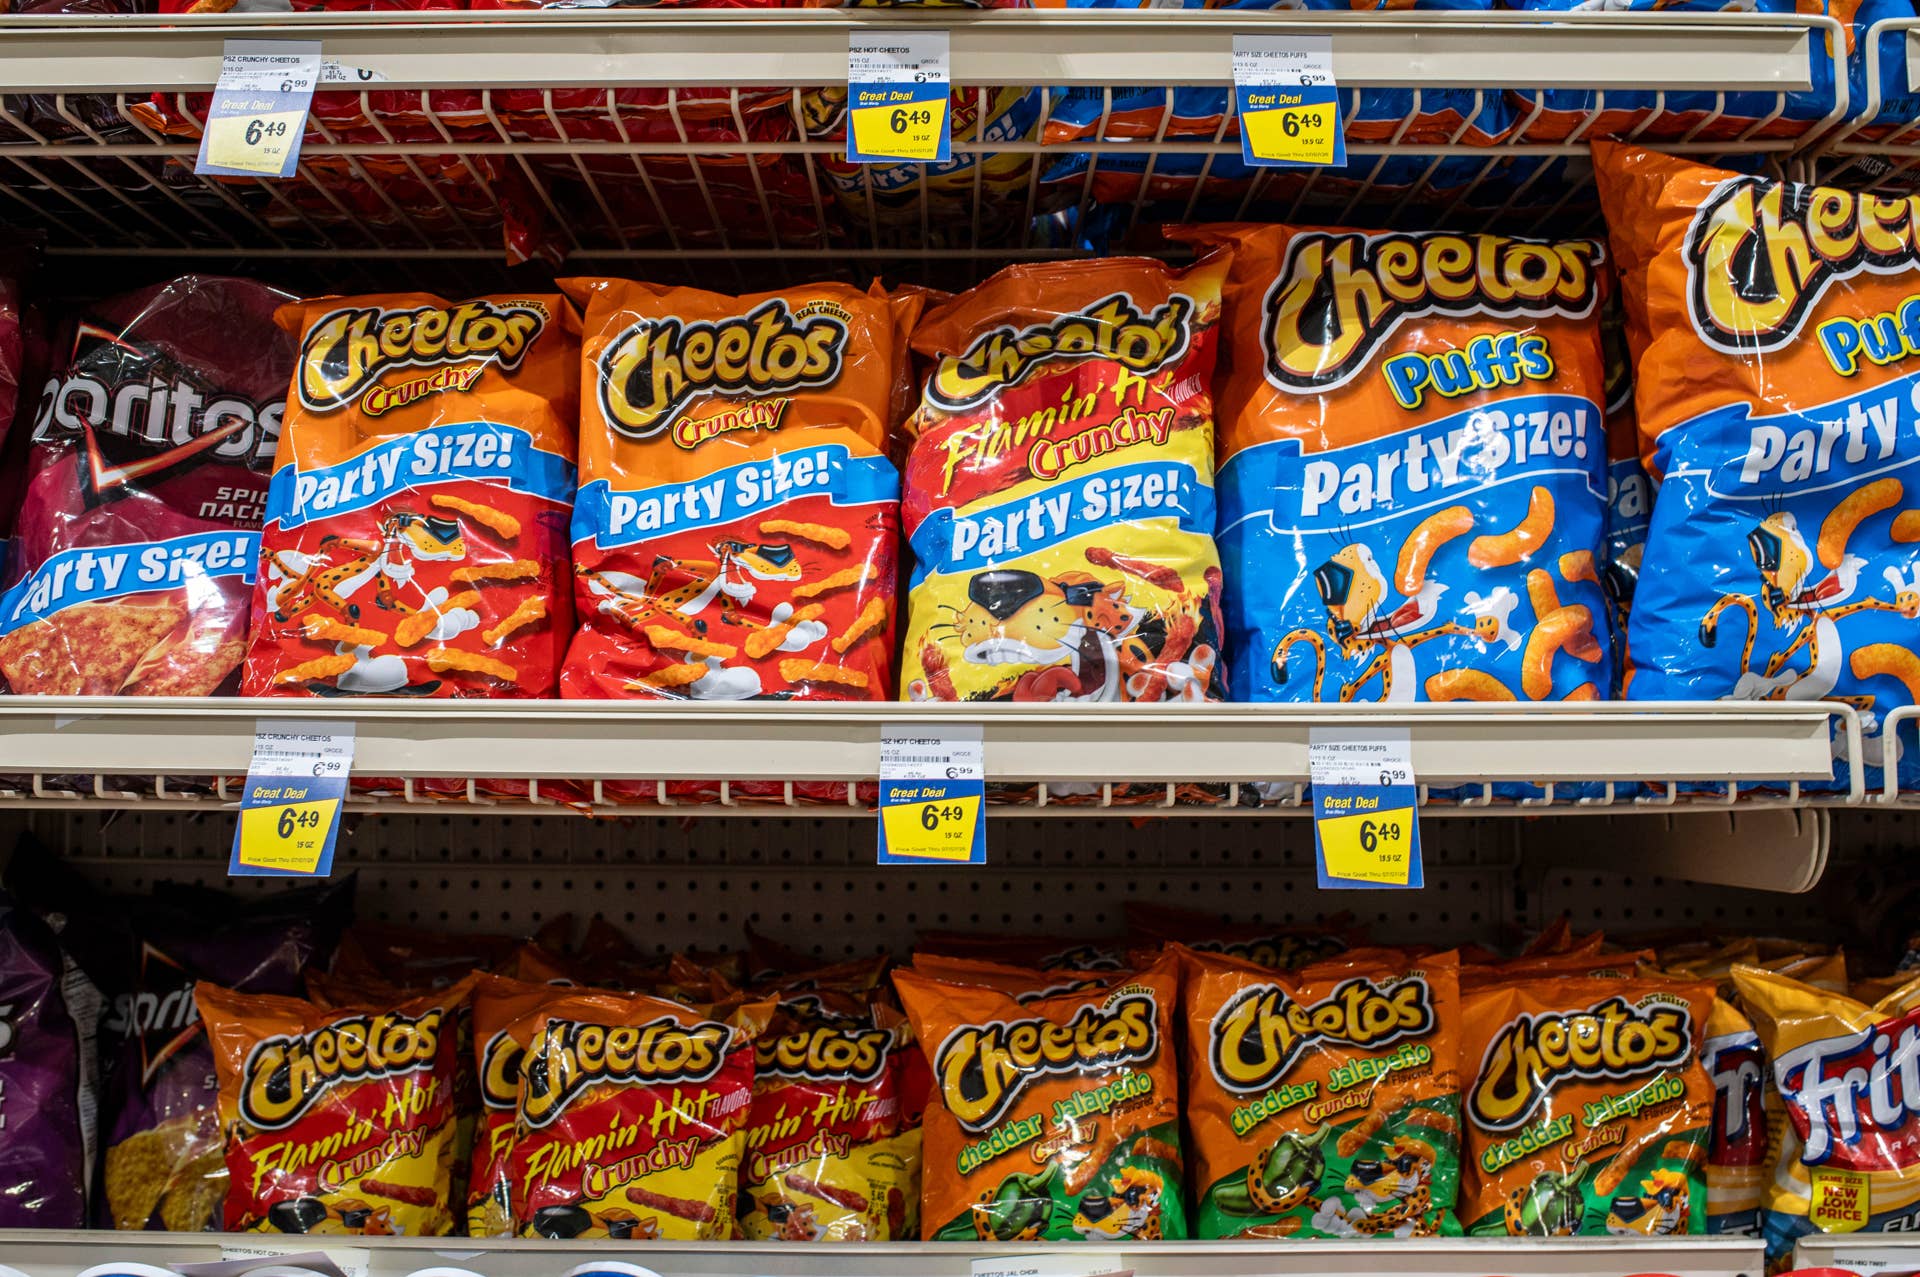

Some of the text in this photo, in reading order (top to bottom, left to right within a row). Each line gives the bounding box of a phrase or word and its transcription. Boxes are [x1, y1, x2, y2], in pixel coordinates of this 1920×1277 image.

[270, 56, 300, 64] CHEETOS
[220, 99, 275, 111] Great Deal
[859, 91, 914, 101] Great Deal
[1249, 94, 1302, 104] Great Deal
[795, 307, 852, 321] REAL CHEESE!
[1276, 235, 1593, 377] Cheetos
[307, 305, 537, 399] Cheetos
[608, 304, 837, 427] Cheetos
[1383, 332, 1554, 409] Puffs
[363, 366, 482, 415] Crunchy
[674, 398, 787, 448] Crunchy
[1029, 407, 1174, 479] Crunchy
[1740, 397, 1899, 483] Party
[292, 433, 515, 518] Party Size!
[610, 450, 828, 535] Party Size!
[1301, 409, 1588, 517] Party Size!
[952, 468, 1179, 561] Party Size!
[11, 536, 250, 623] Party Size!
[253, 787, 308, 799] Great Deal
[890, 787, 946, 798] Great Deal
[1324, 796, 1379, 808] Great Deal
[1218, 979, 1428, 1083] Cheetos
[249, 1014, 441, 1118] Cheetos
[522, 1021, 730, 1121] Cheetos
[942, 1003, 1152, 1123] Cheetos
[1327, 1042, 1432, 1094] Jalapeño
[1475, 1003, 1682, 1121] Cheetos
[811, 1085, 878, 1127] Hot
[1051, 1069, 1152, 1126] Jalapeño
[1303, 1086, 1374, 1126] Crunchy
[1581, 1075, 1685, 1129] Jalapeño
[249, 1075, 440, 1199] Flamin' Hot
[317, 1124, 427, 1192] Crunchy
[522, 1107, 642, 1202] Flamin'
[653, 1086, 722, 1137] Hot
[749, 1128, 850, 1184] Crunchy
[1560, 1124, 1626, 1165] Crunchy
[582, 1136, 700, 1199] Crunchy
[1824, 1186, 1858, 1198] NEW
[1816, 1207, 1862, 1221] PRICE
[1823, 1198, 1857, 1209] LOW
